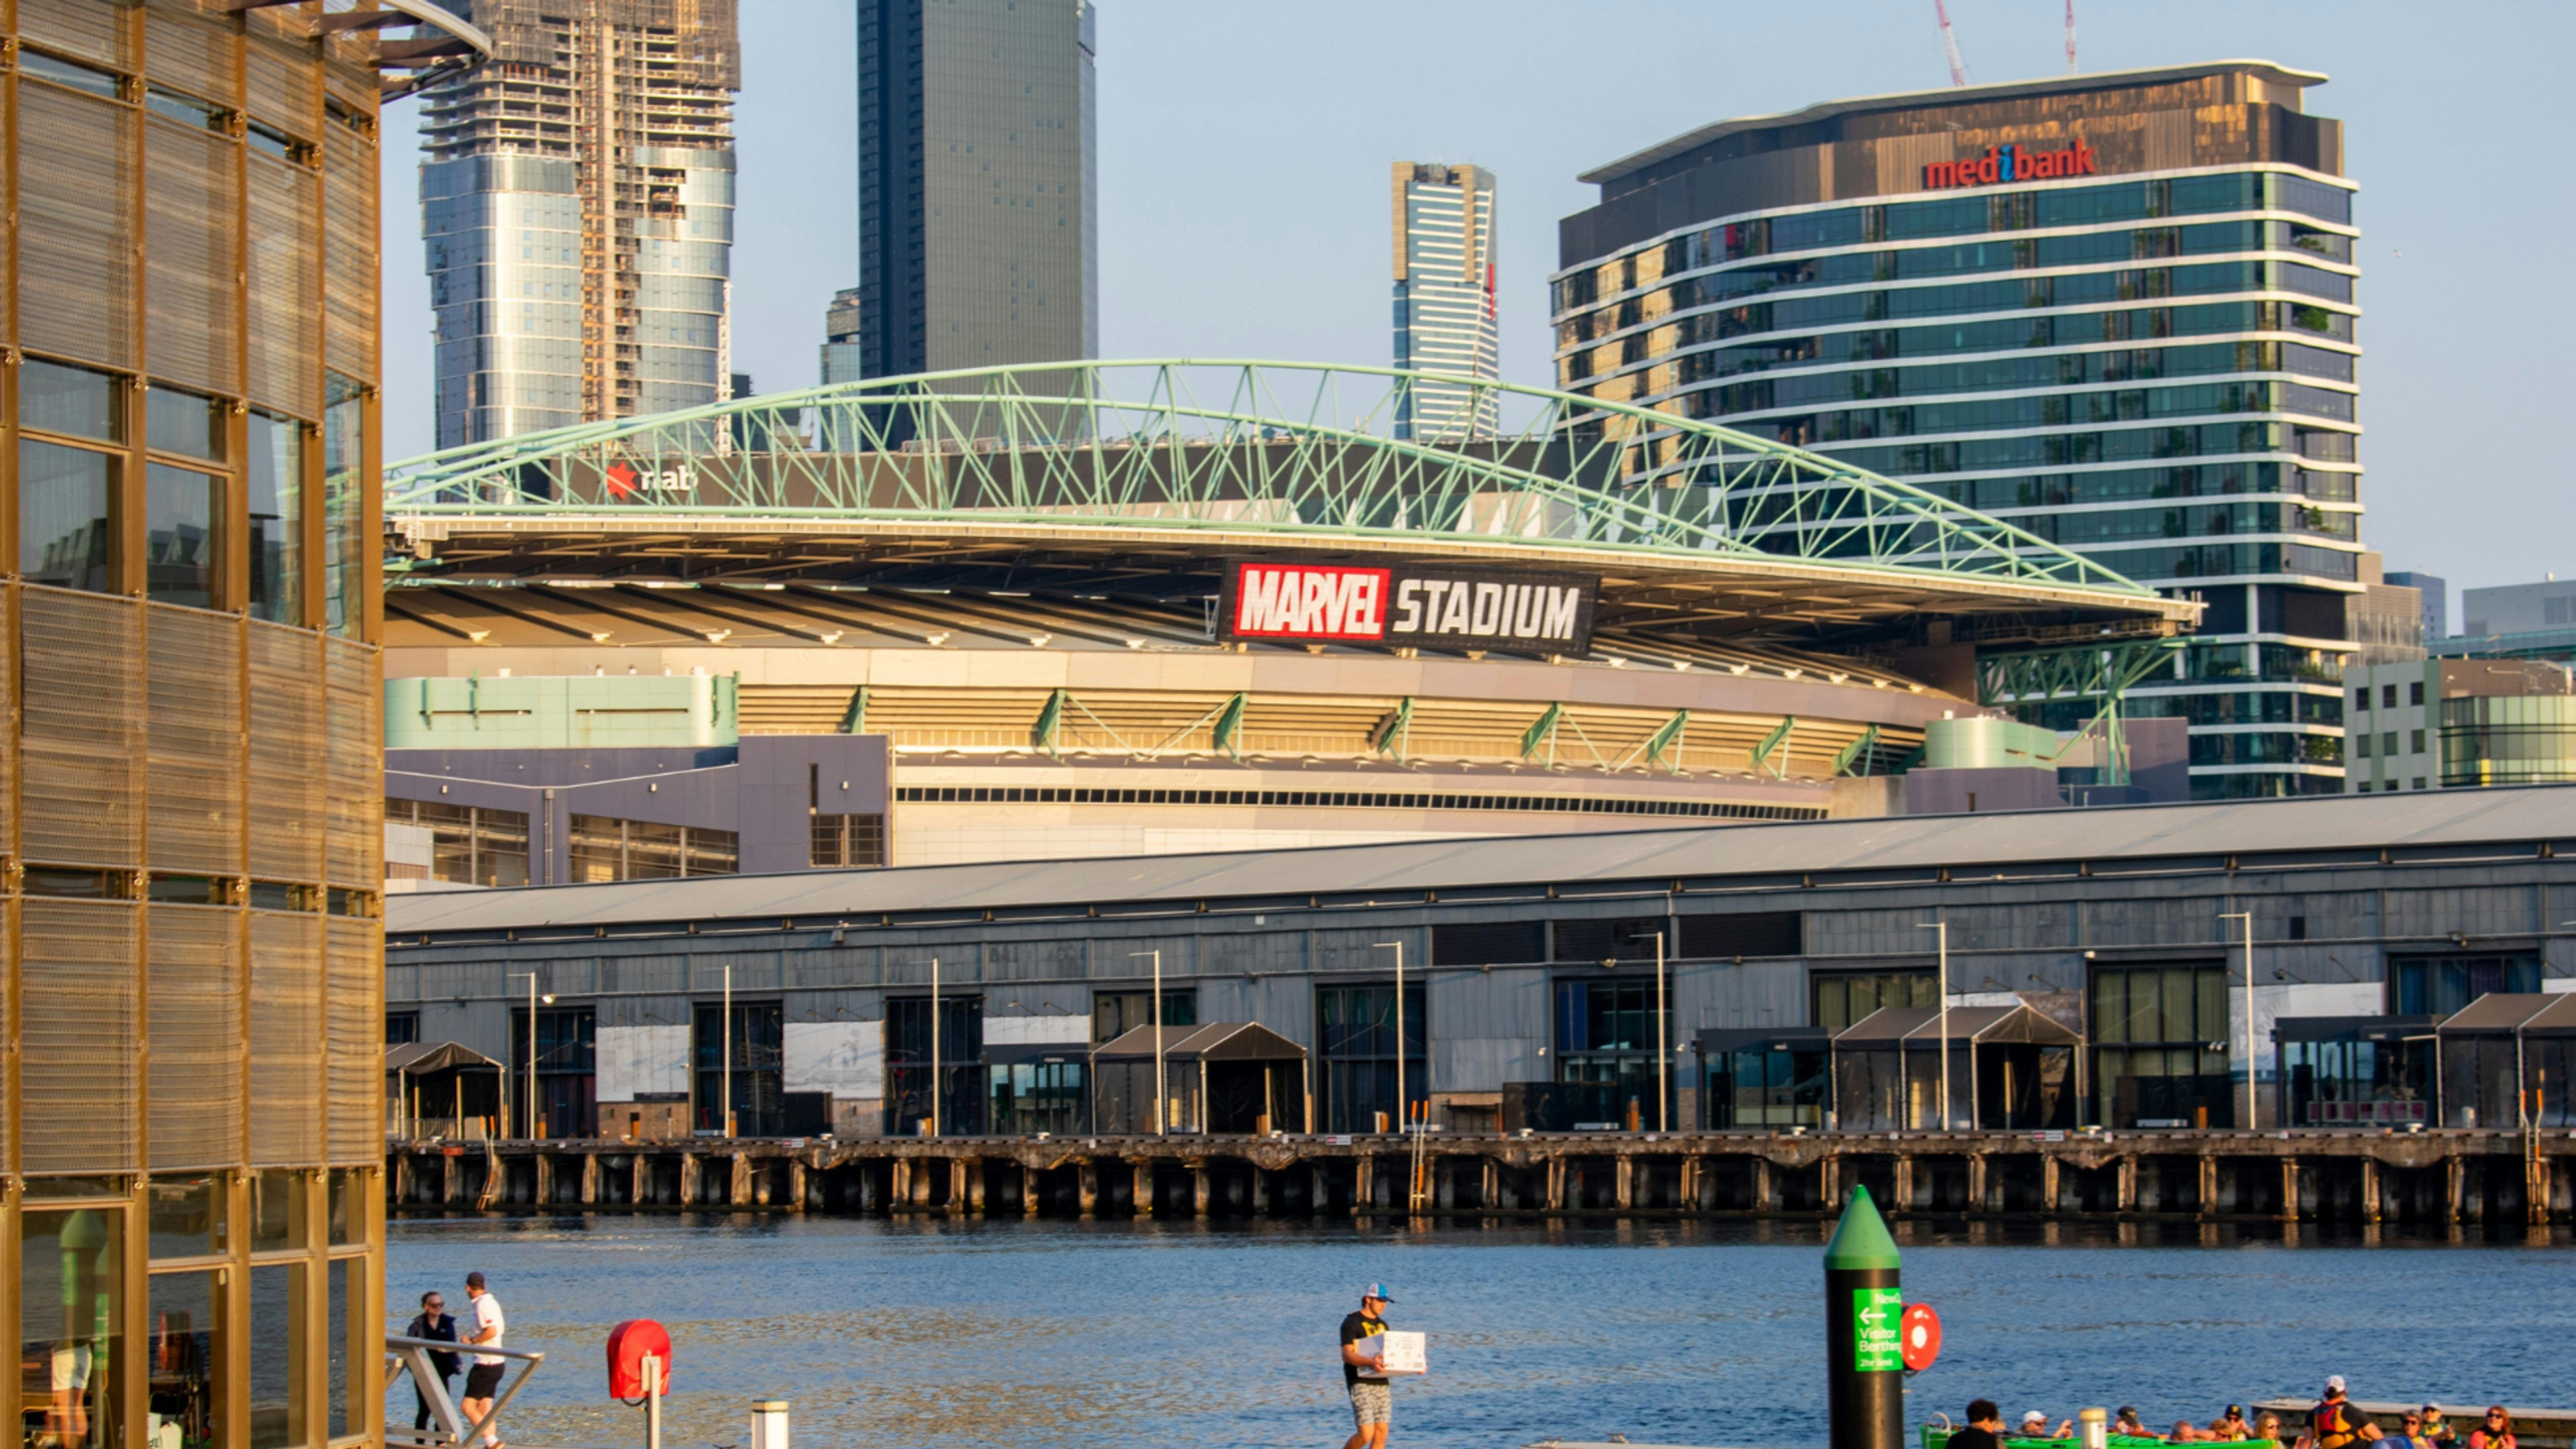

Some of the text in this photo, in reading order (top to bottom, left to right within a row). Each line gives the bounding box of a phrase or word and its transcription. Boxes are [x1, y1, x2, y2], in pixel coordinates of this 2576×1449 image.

[1923, 138, 2096, 189] medibank
[641, 465, 698, 491] nab
[1239, 570, 1580, 640] MARVEL STADIUM
[1860, 1328, 1896, 1339] Visitor
